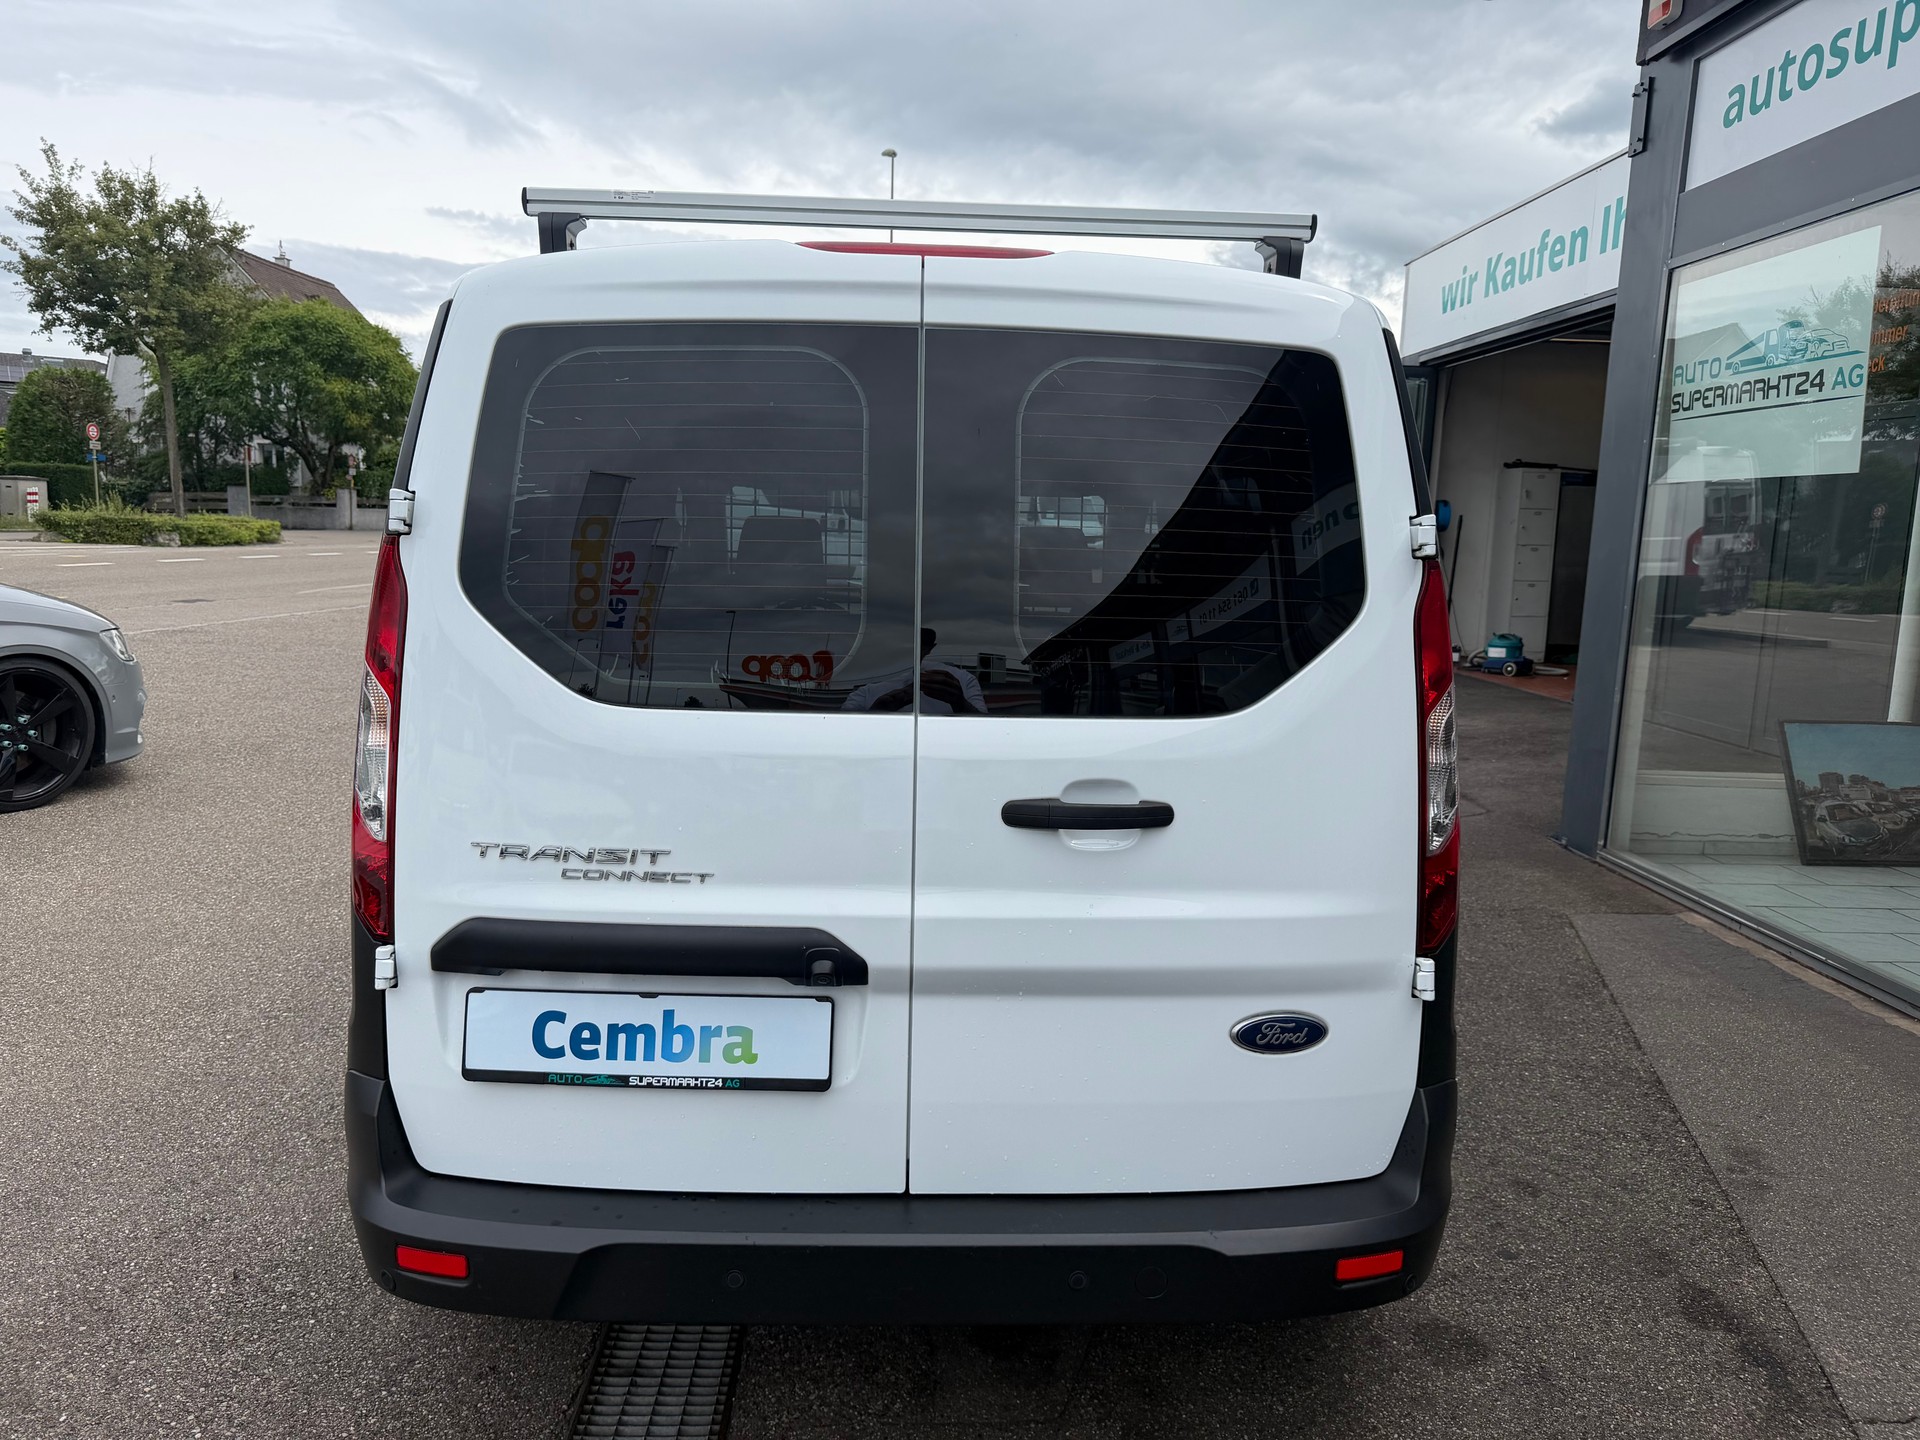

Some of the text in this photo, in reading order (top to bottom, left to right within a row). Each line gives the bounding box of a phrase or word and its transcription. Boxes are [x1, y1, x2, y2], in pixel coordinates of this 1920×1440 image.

[1722, 0, 1920, 129] autosup
[1441, 265, 1479, 315] wir
[1484, 225, 1589, 298] Kaufen
[1673, 357, 1722, 387] AUTO
[1671, 363, 1865, 414] SUPERMARKT24 AG
[470, 841, 671, 866] TRANSIT
[560, 867, 715, 884] CONNECT
[531, 1009, 759, 1065] Cembra
[1256, 1022, 1309, 1045] Ford
[548, 1074, 583, 1084] AUTO
[725, 1079, 740, 1088] AG
